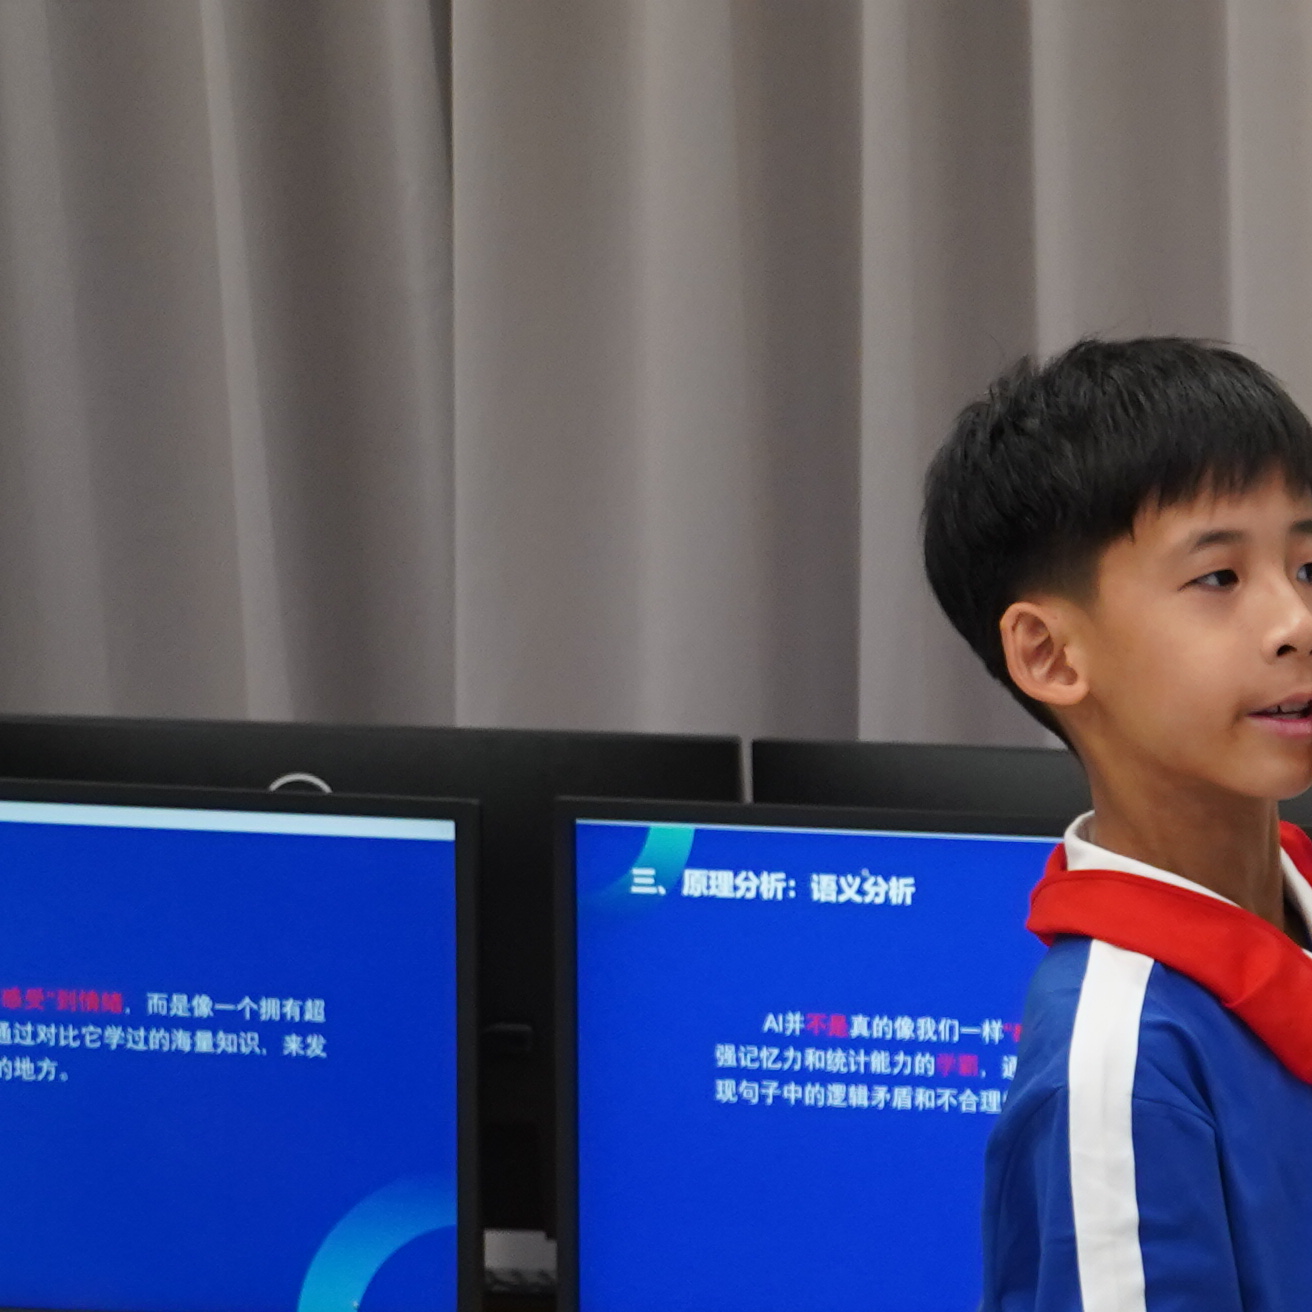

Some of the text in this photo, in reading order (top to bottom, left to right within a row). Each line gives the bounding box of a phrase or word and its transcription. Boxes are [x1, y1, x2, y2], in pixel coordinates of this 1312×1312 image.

[630, 867, 916, 905] 三、原理分析：语义分析
[715, 1078, 1008, 1115] 现句子中的逻辑矛盾和不合理
